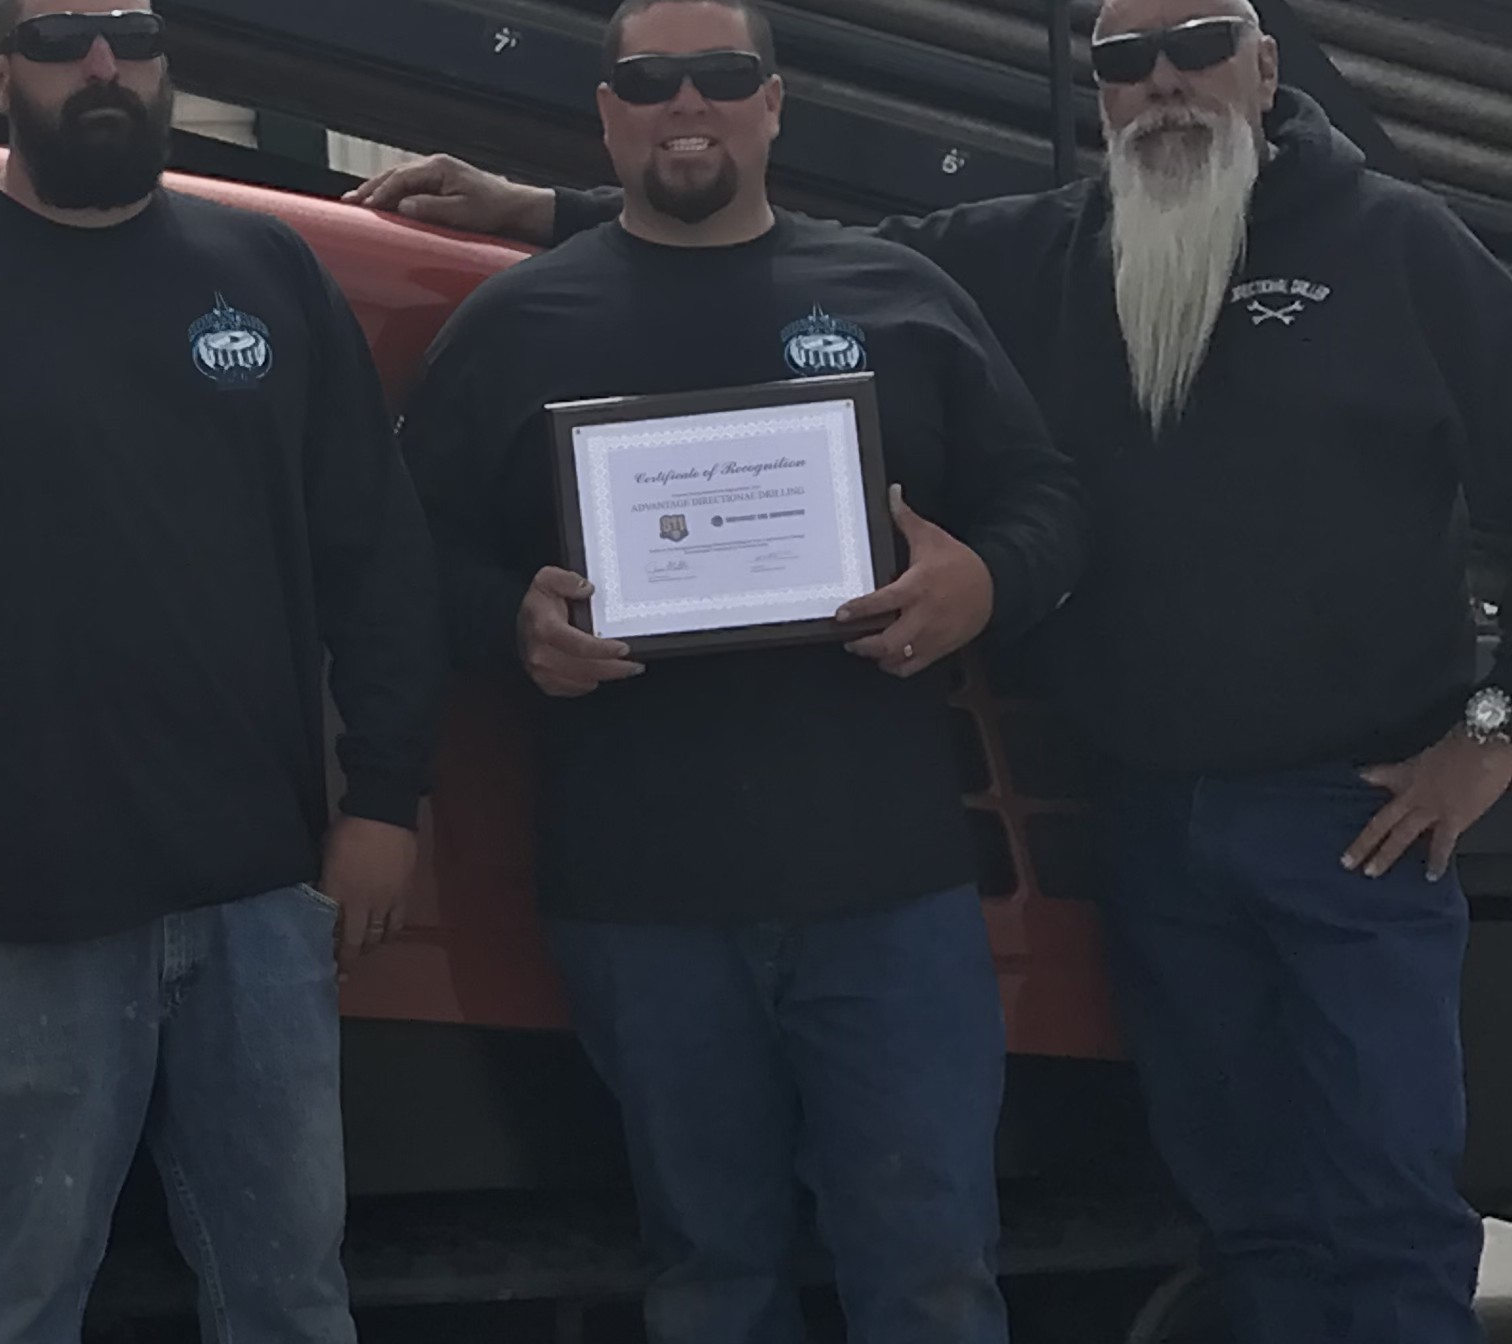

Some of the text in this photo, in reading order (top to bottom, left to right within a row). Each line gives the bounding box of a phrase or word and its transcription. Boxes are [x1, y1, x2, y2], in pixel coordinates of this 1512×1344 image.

[634, 456, 806, 486] Certificate of Recognition
